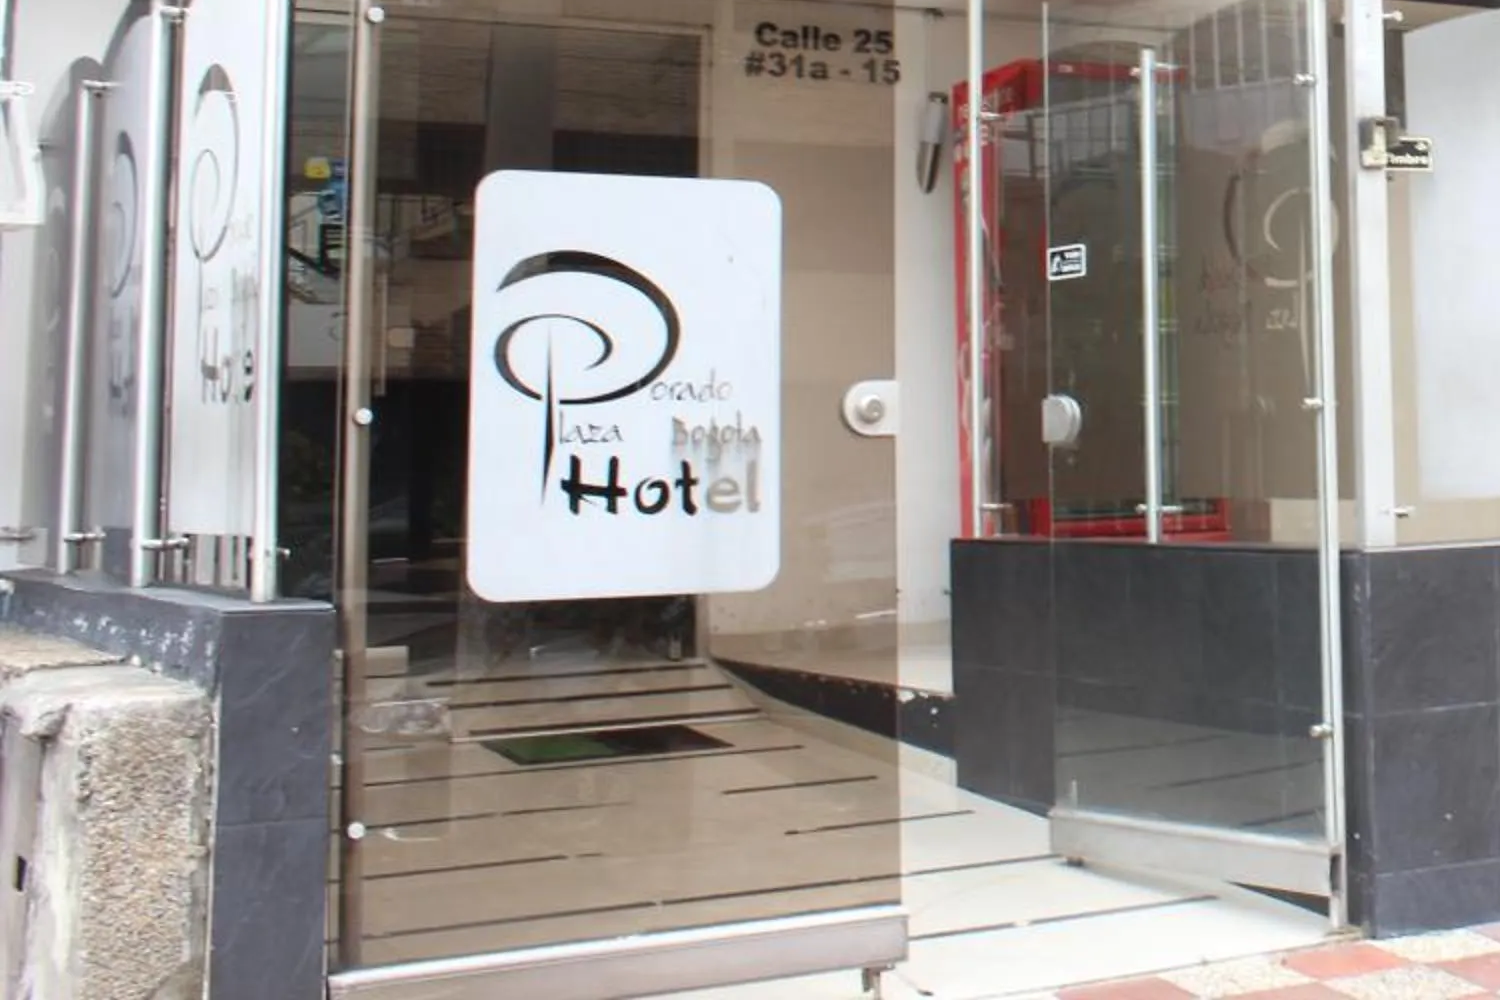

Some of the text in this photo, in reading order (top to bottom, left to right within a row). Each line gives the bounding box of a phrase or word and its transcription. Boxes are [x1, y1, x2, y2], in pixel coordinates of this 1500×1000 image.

[755, 21, 894, 54] Calle 25
[745, 51, 829, 80] #31a
[862, 57, 901, 85] 15
[560, 453, 760, 516] Hotel
